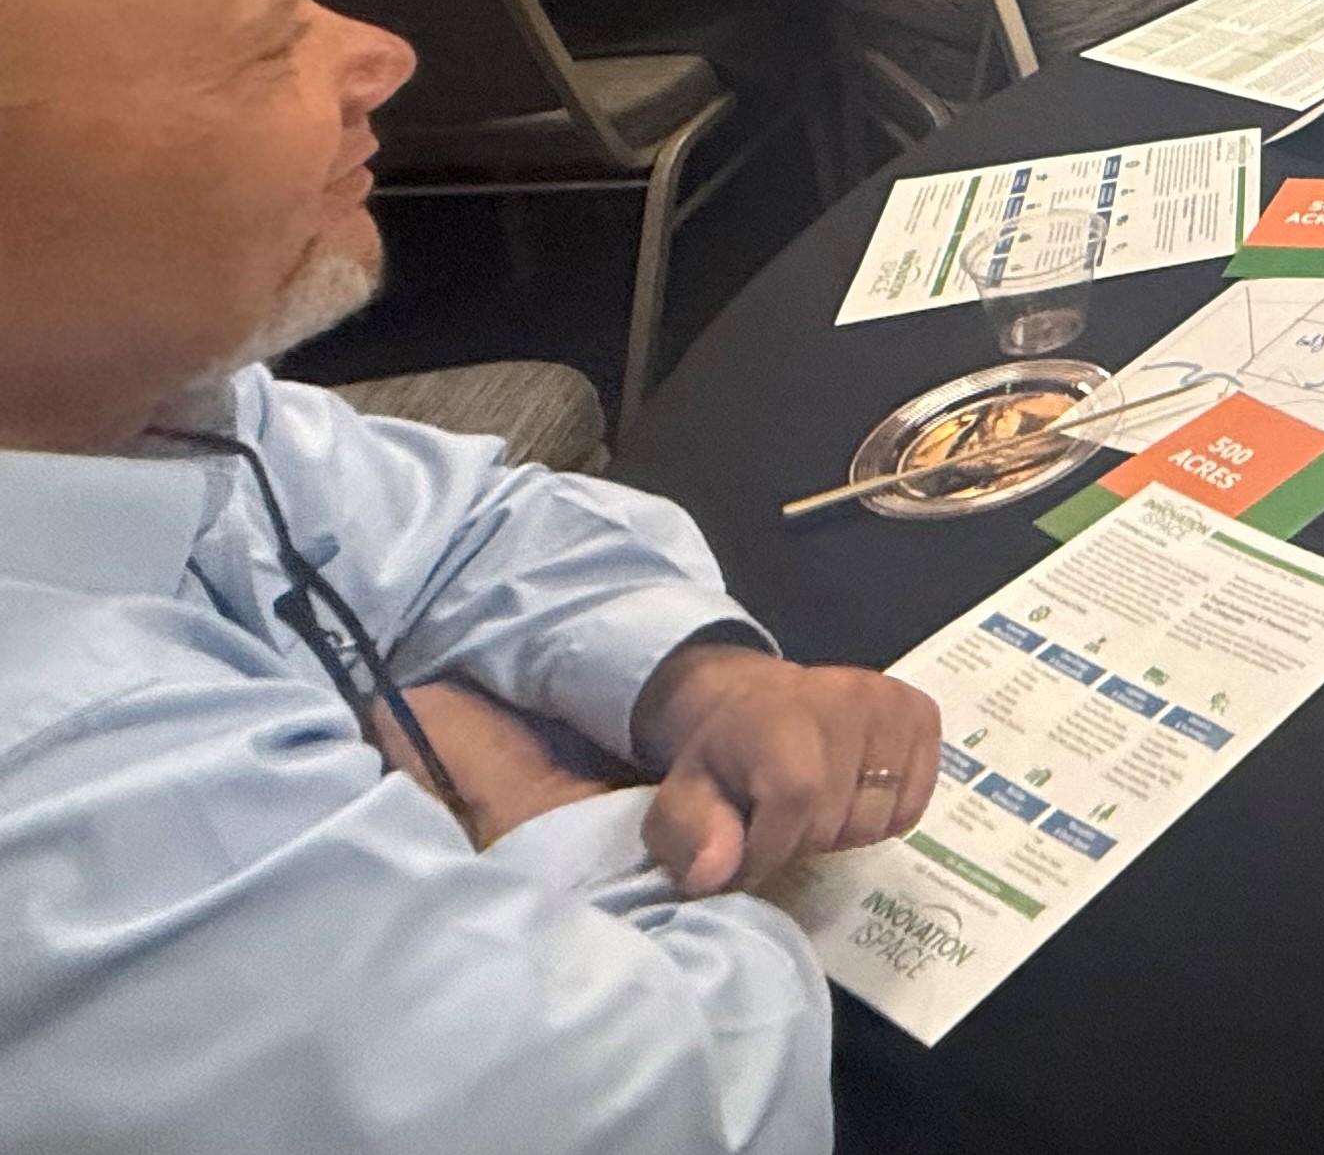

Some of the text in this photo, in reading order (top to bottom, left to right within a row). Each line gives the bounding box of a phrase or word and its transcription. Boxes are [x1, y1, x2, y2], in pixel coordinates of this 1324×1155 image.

[1168, 448, 1242, 490] ACRES
[1208, 436, 1254, 465] 500
[861, 890, 976, 969] INNOVATION
